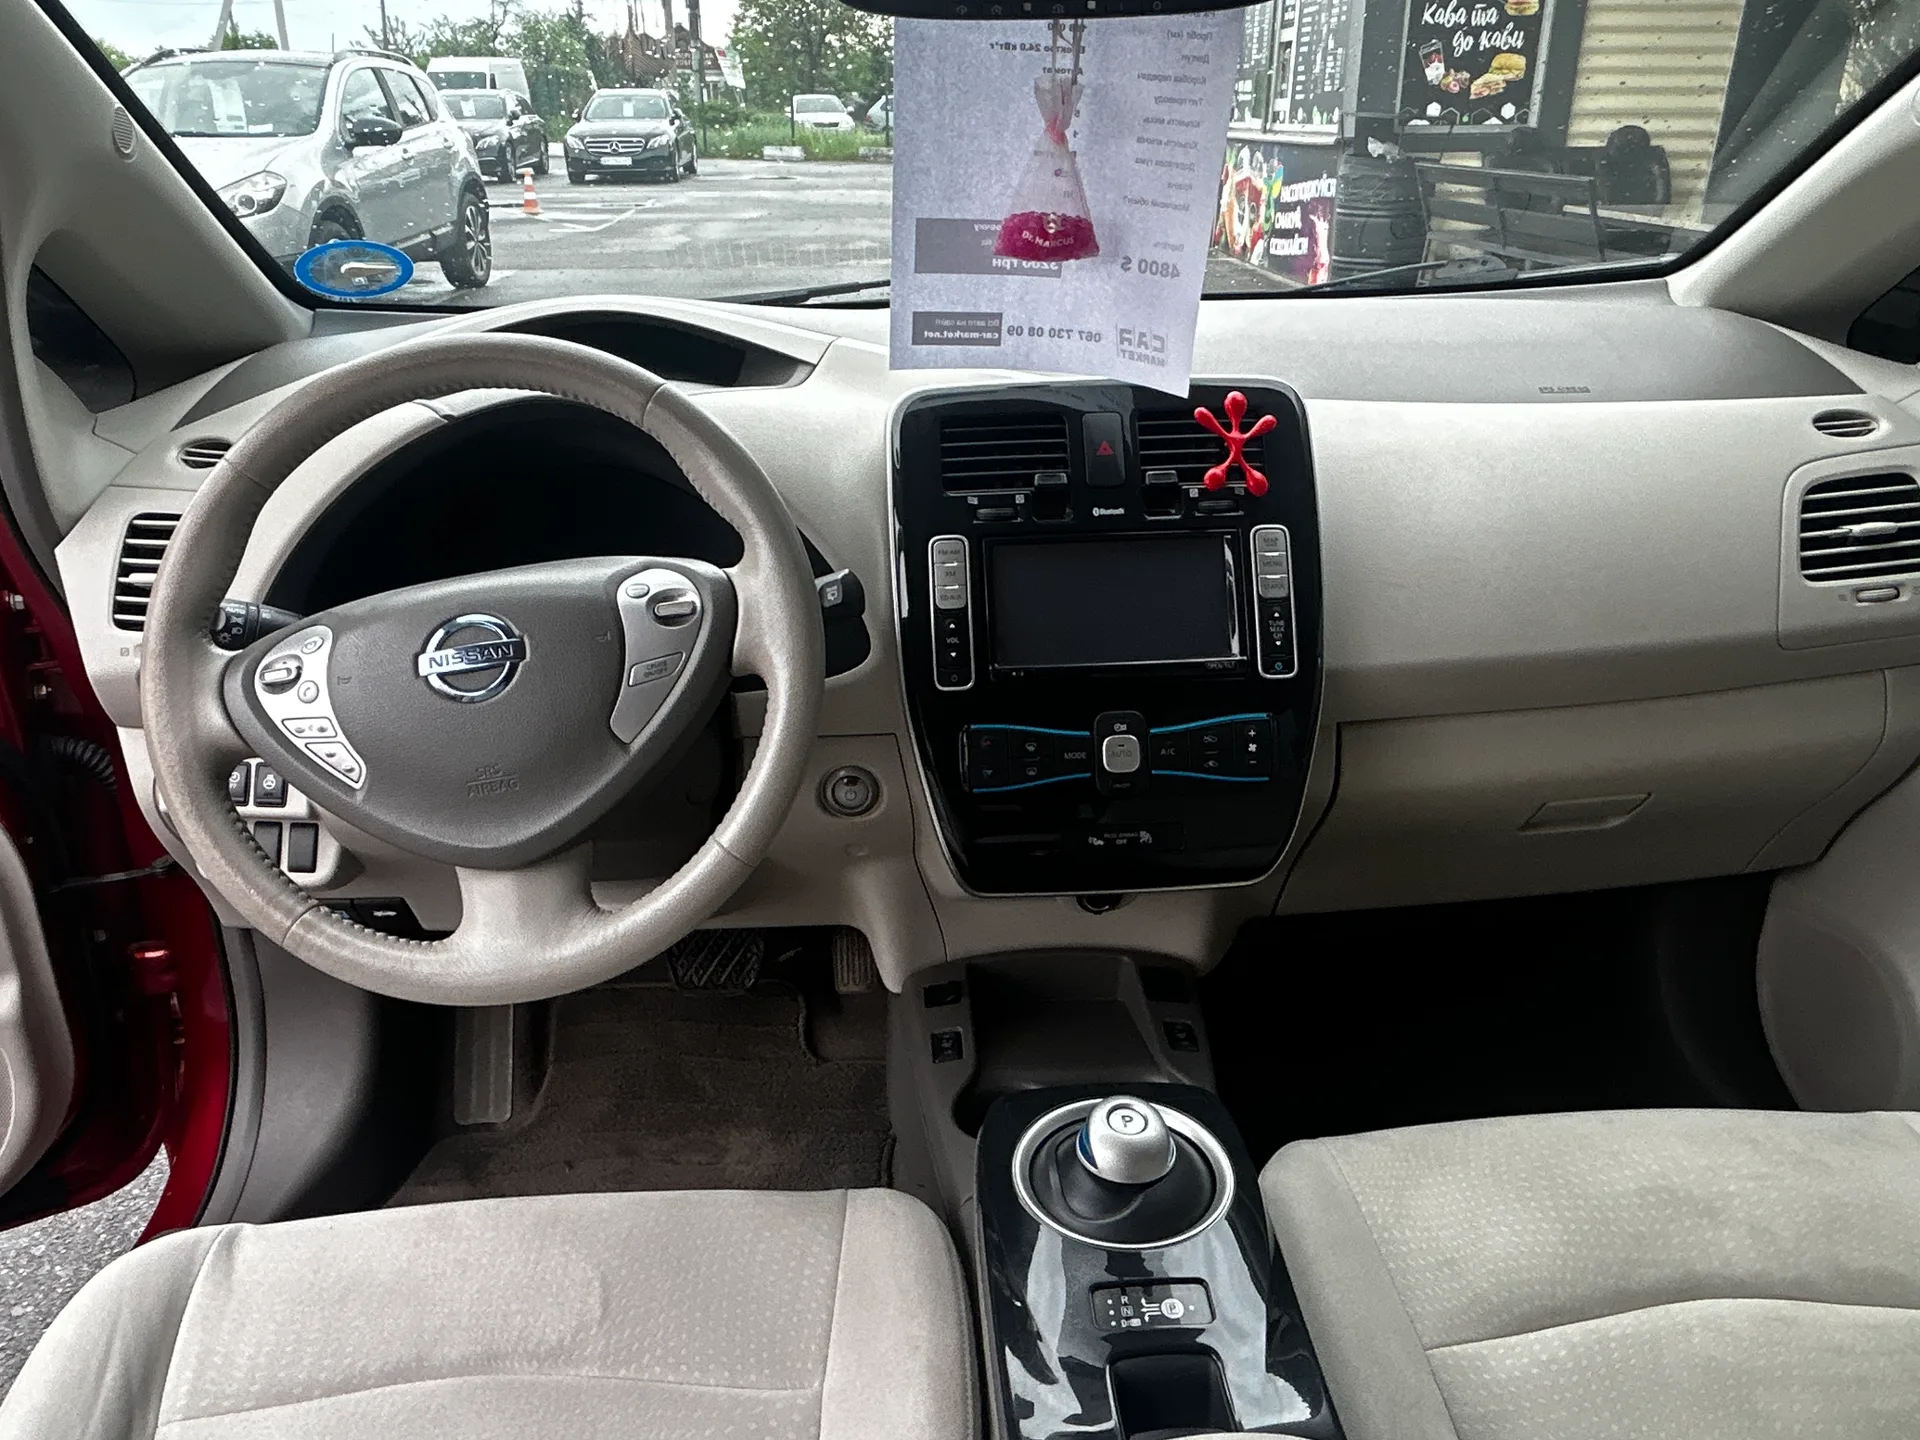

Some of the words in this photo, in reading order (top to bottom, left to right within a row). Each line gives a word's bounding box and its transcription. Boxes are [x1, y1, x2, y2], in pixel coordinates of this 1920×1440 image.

[1420, 0, 1468, 28] Кава
[1452, 25, 1475, 57] до
[1478, 21, 1525, 51] кави
[1021, 230, 1034, 242] Dr.
[1034, 236, 1075, 249] MARCUS
[428, 642, 515, 670] NISSAN
[1063, 751, 1087, 760] MODE
[1160, 748, 1176, 756] A/C
[1121, 1115, 1134, 1128] P
[1121, 1295, 1129, 1304] R
